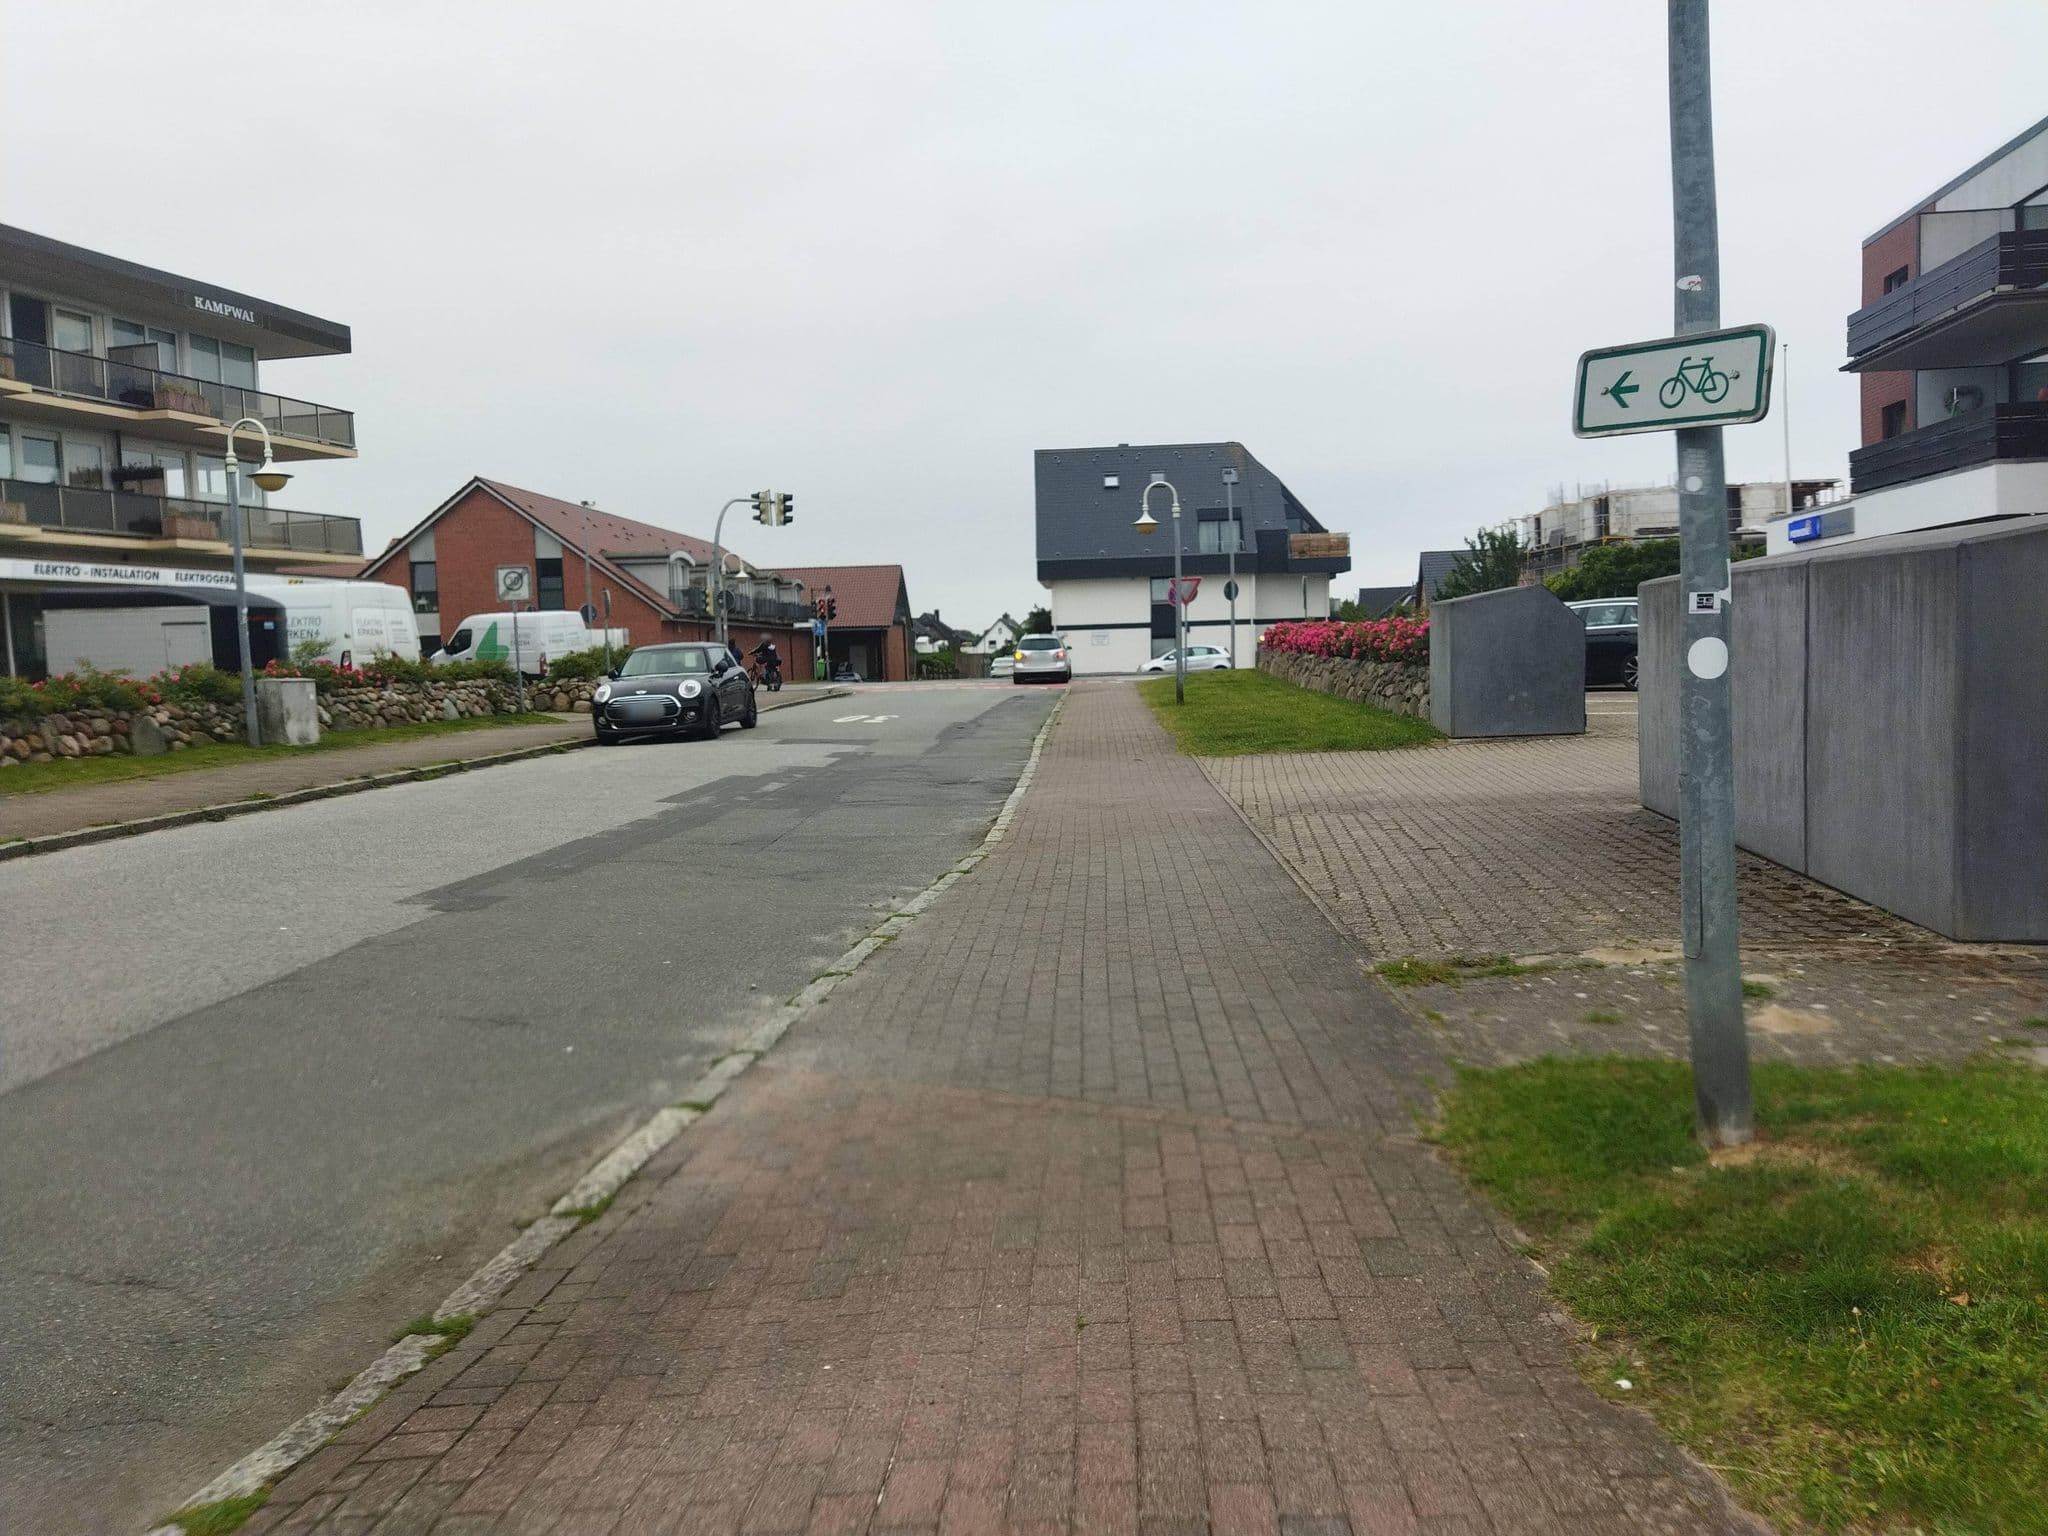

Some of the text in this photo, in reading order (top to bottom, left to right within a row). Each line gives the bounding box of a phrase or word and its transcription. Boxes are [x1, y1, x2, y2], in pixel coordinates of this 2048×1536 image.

[193, 295, 255, 323] KAMPWAI
[33, 564, 81, 576] ELEKTRO
[90, 567, 160, 582] INSTALLATION
